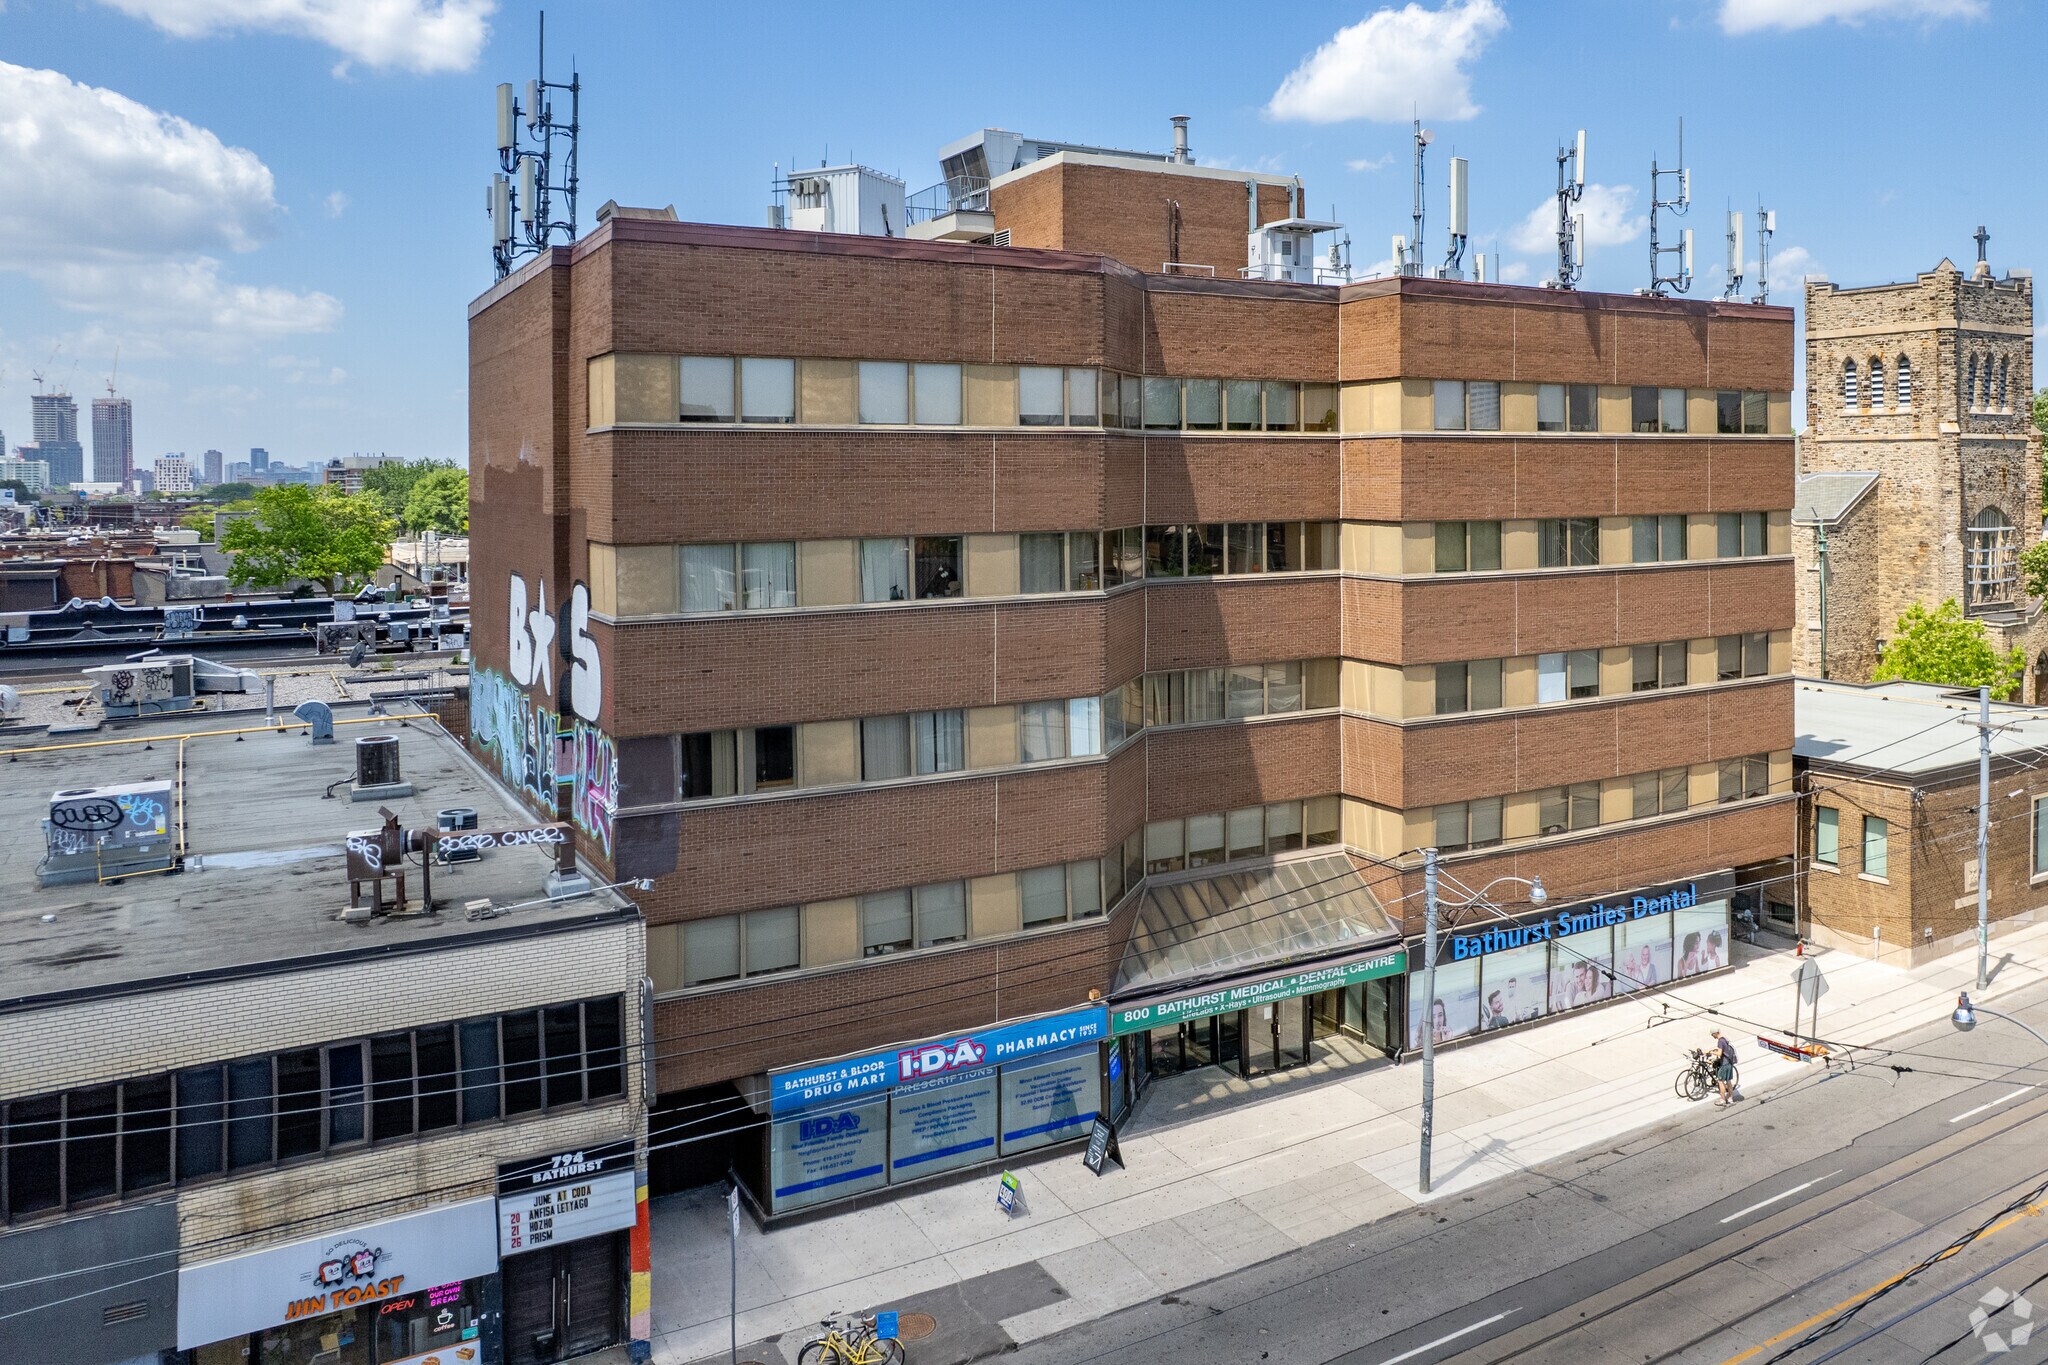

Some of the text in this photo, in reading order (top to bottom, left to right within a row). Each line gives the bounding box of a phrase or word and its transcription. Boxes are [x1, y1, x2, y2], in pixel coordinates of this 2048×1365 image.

[1453, 884, 1697, 961] Bathurst Smiles Dental
[1124, 954, 1396, 1022] 800 BATHURST MEDICAL DENTAL CENTRE
[1220, 1000, 1247, 1011] X-Rays
[1252, 988, 1291, 1004] Ultrasound
[1296, 978, 1346, 995] Mammography
[1080, 1022, 1097, 1032] SINCE
[997, 1027, 1077, 1056] PHARMACY
[785, 1061, 885, 1090] BATHURST & BLOOR
[804, 1073, 886, 1099] DRUG MART
[894, 1067, 994, 1095] PRESCRIPTIONS
[552, 1151, 584, 1169] 794
[532, 1160, 603, 1183] BATHURST
[534, 1185, 591, 1207] JUNE AT CODA
[511, 1198, 588, 1224] 20 ANFISA LETYAGO
[511, 1226, 519, 1236] 21
[511, 1230, 552, 1248] 26 PRISM
[326, 1239, 368, 1256] SO DELICIOUS
[285, 1274, 405, 1320] JJIN TOAST
[429, 1286, 461, 1299] OUR OWN
[430, 1295, 459, 1307] BREAD
[381, 1299, 415, 1315] OPEN
[433, 1323, 455, 1333] coffee
